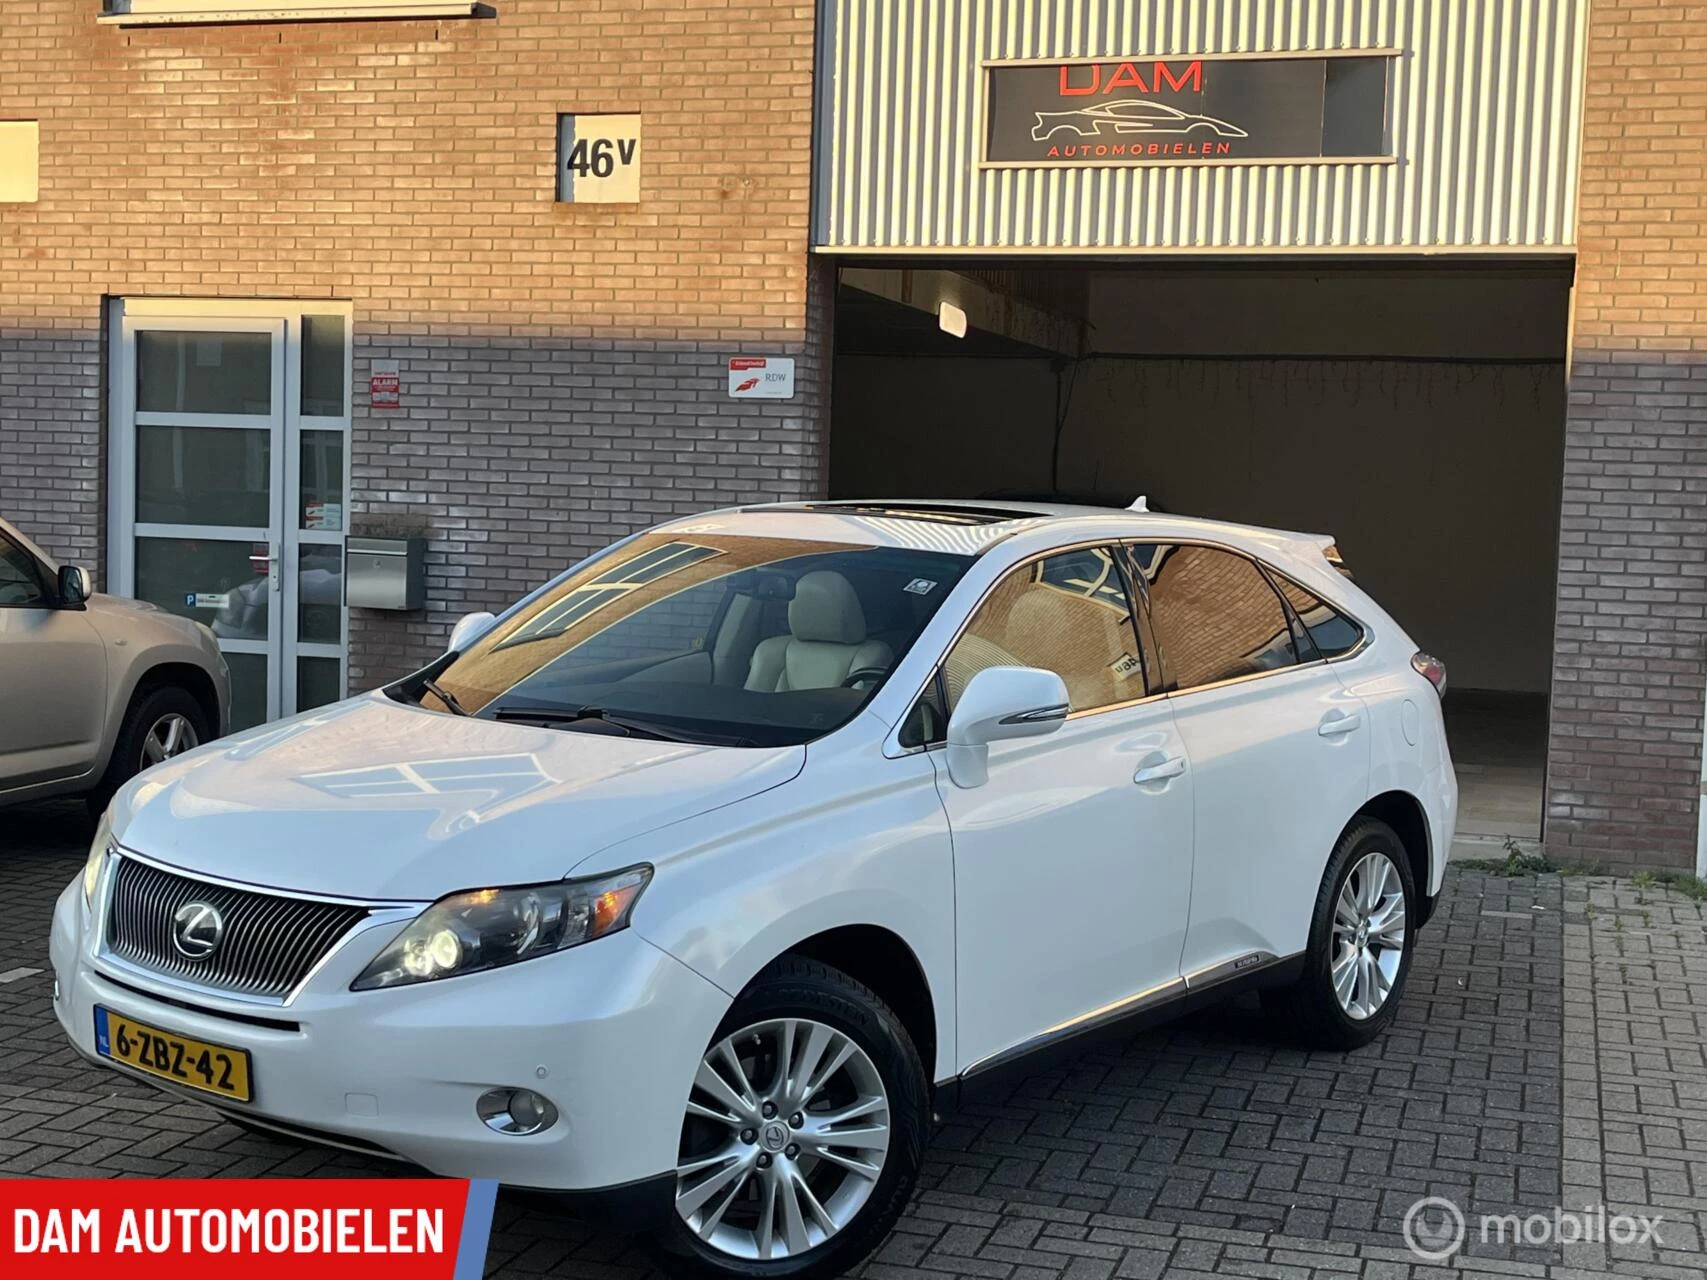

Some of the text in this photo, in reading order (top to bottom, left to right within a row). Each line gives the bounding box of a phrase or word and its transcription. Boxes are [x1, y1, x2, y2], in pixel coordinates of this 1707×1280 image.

[1059, 60, 1202, 96] DAM
[1047, 142, 1231, 157] AUTOMOBIELEN
[372, 378, 398, 386] ALARM
[765, 373, 787, 382] RDW
[116, 1023, 235, 1091] 6-ZBZ-42
